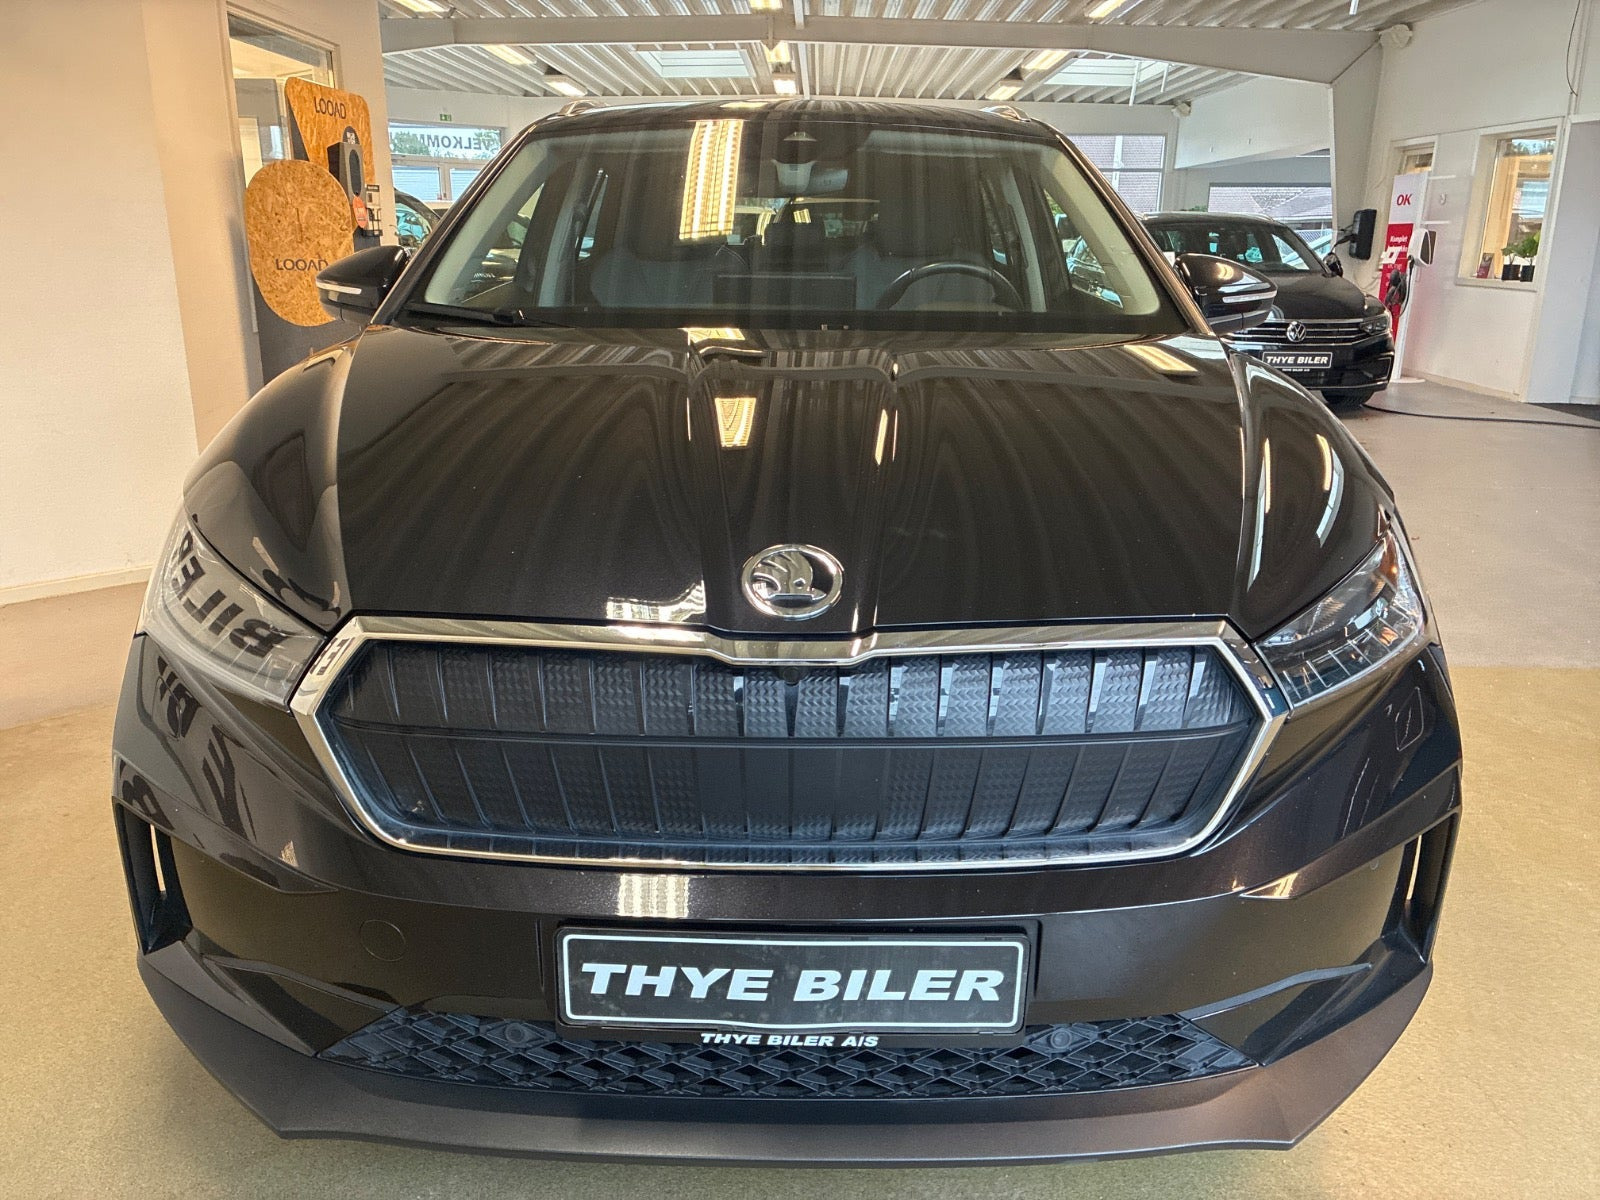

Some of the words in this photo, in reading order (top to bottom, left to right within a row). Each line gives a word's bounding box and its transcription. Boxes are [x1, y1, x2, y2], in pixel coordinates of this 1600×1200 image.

[313, 96, 347, 119] LOOAD
[1396, 193, 1412, 206] OK
[1266, 356, 1295, 364] THYE
[1297, 356, 1328, 364] BILER
[581, 963, 774, 1001] THYE
[793, 969, 1005, 1002] BILER
[700, 1032, 762, 1045] THYE
[766, 1034, 835, 1047] BILER
